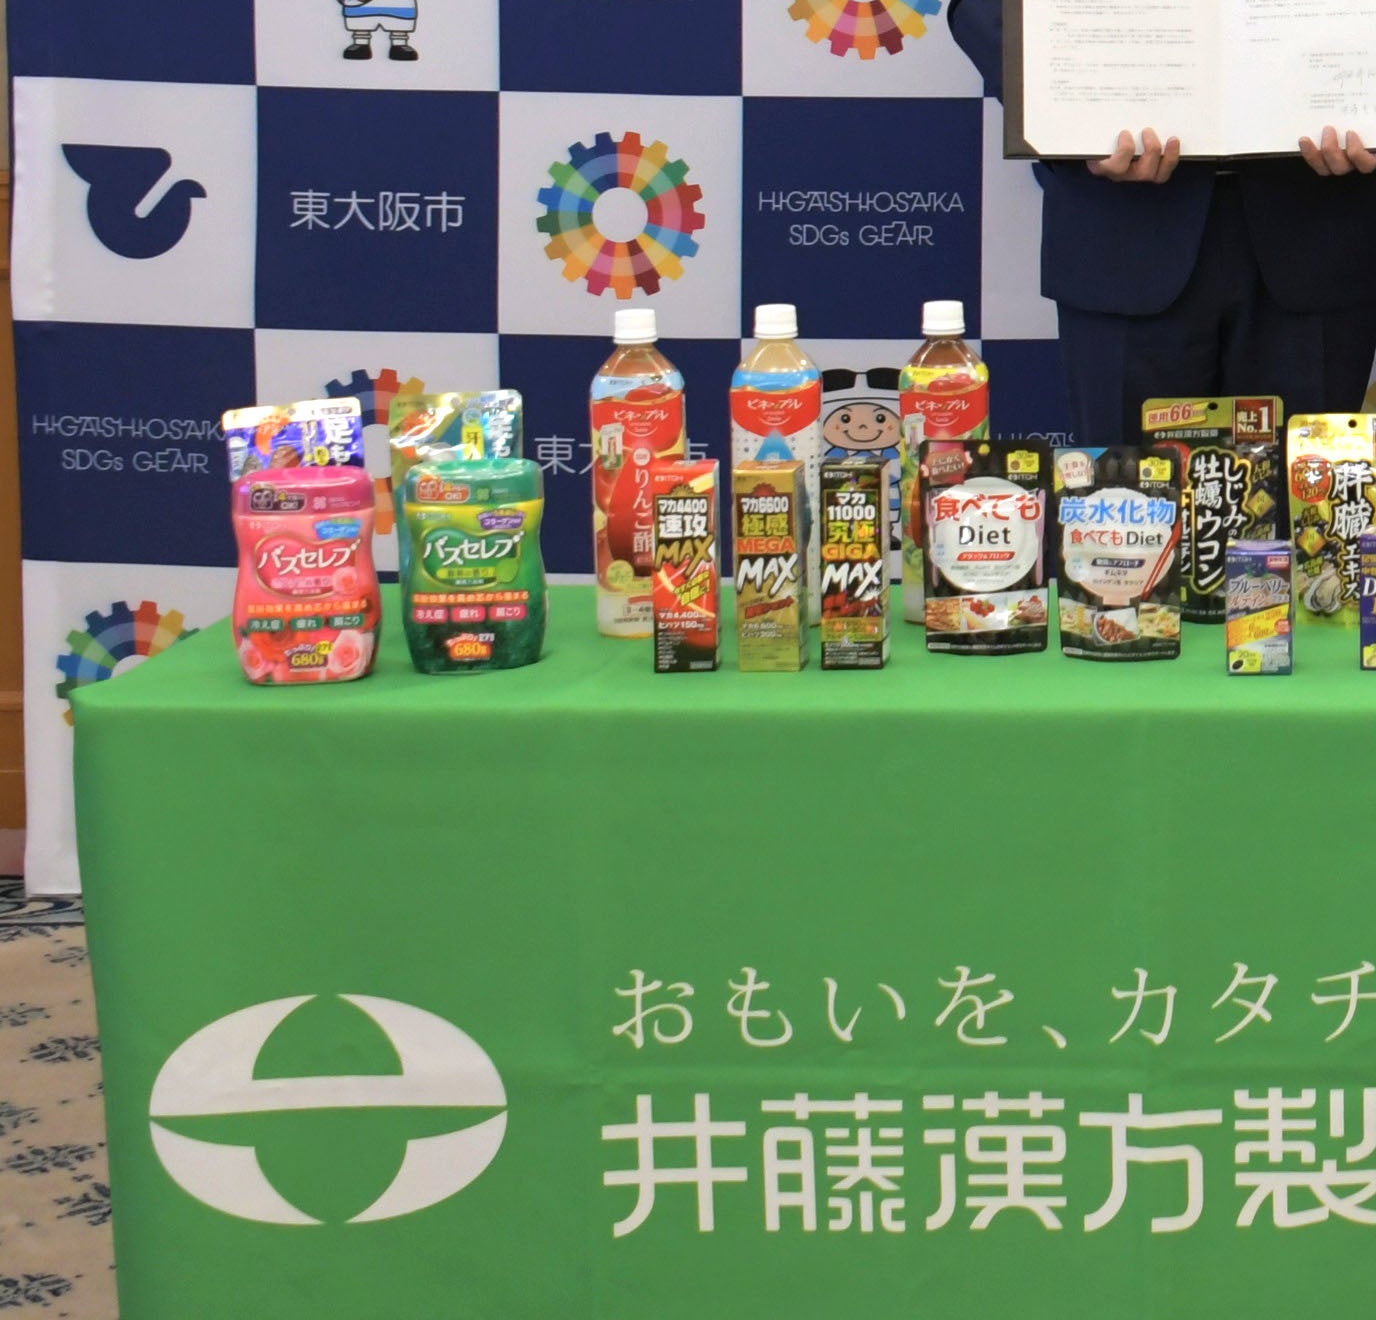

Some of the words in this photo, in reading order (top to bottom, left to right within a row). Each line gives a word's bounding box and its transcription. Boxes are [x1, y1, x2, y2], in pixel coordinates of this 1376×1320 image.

[290, 189, 465, 232] 東大阪市
[759, 191, 964, 212] HIGASHIOSAKA
[789, 224, 849, 245] SDGs
[859, 221, 934, 246] GEAR
[62, 449, 123, 471] SDGs
[132, 448, 209, 474] GEAR
[658, 498, 707, 514] マカ4400
[741, 496, 789, 513] マカ6600
[836, 492, 866, 505] マカ
[935, 494, 1041, 521] 食べても
[1060, 497, 1175, 525] 炭水化物
[827, 504, 875, 521] 11000
[1194, 454, 1224, 587] 牡蠣ウコン
[658, 514, 707, 538] 速攻
[959, 524, 1011, 545] Diet
[258, 538, 361, 575] バスセレブ
[423, 531, 524, 566] バスセレブ
[654, 534, 715, 577] MAX
[737, 536, 795, 554] MEGA
[822, 543, 880, 560] GIGA
[737, 553, 798, 598] MAX
[821, 559, 882, 598] MAX
[1231, 580, 1289, 593] ブルーベリー
